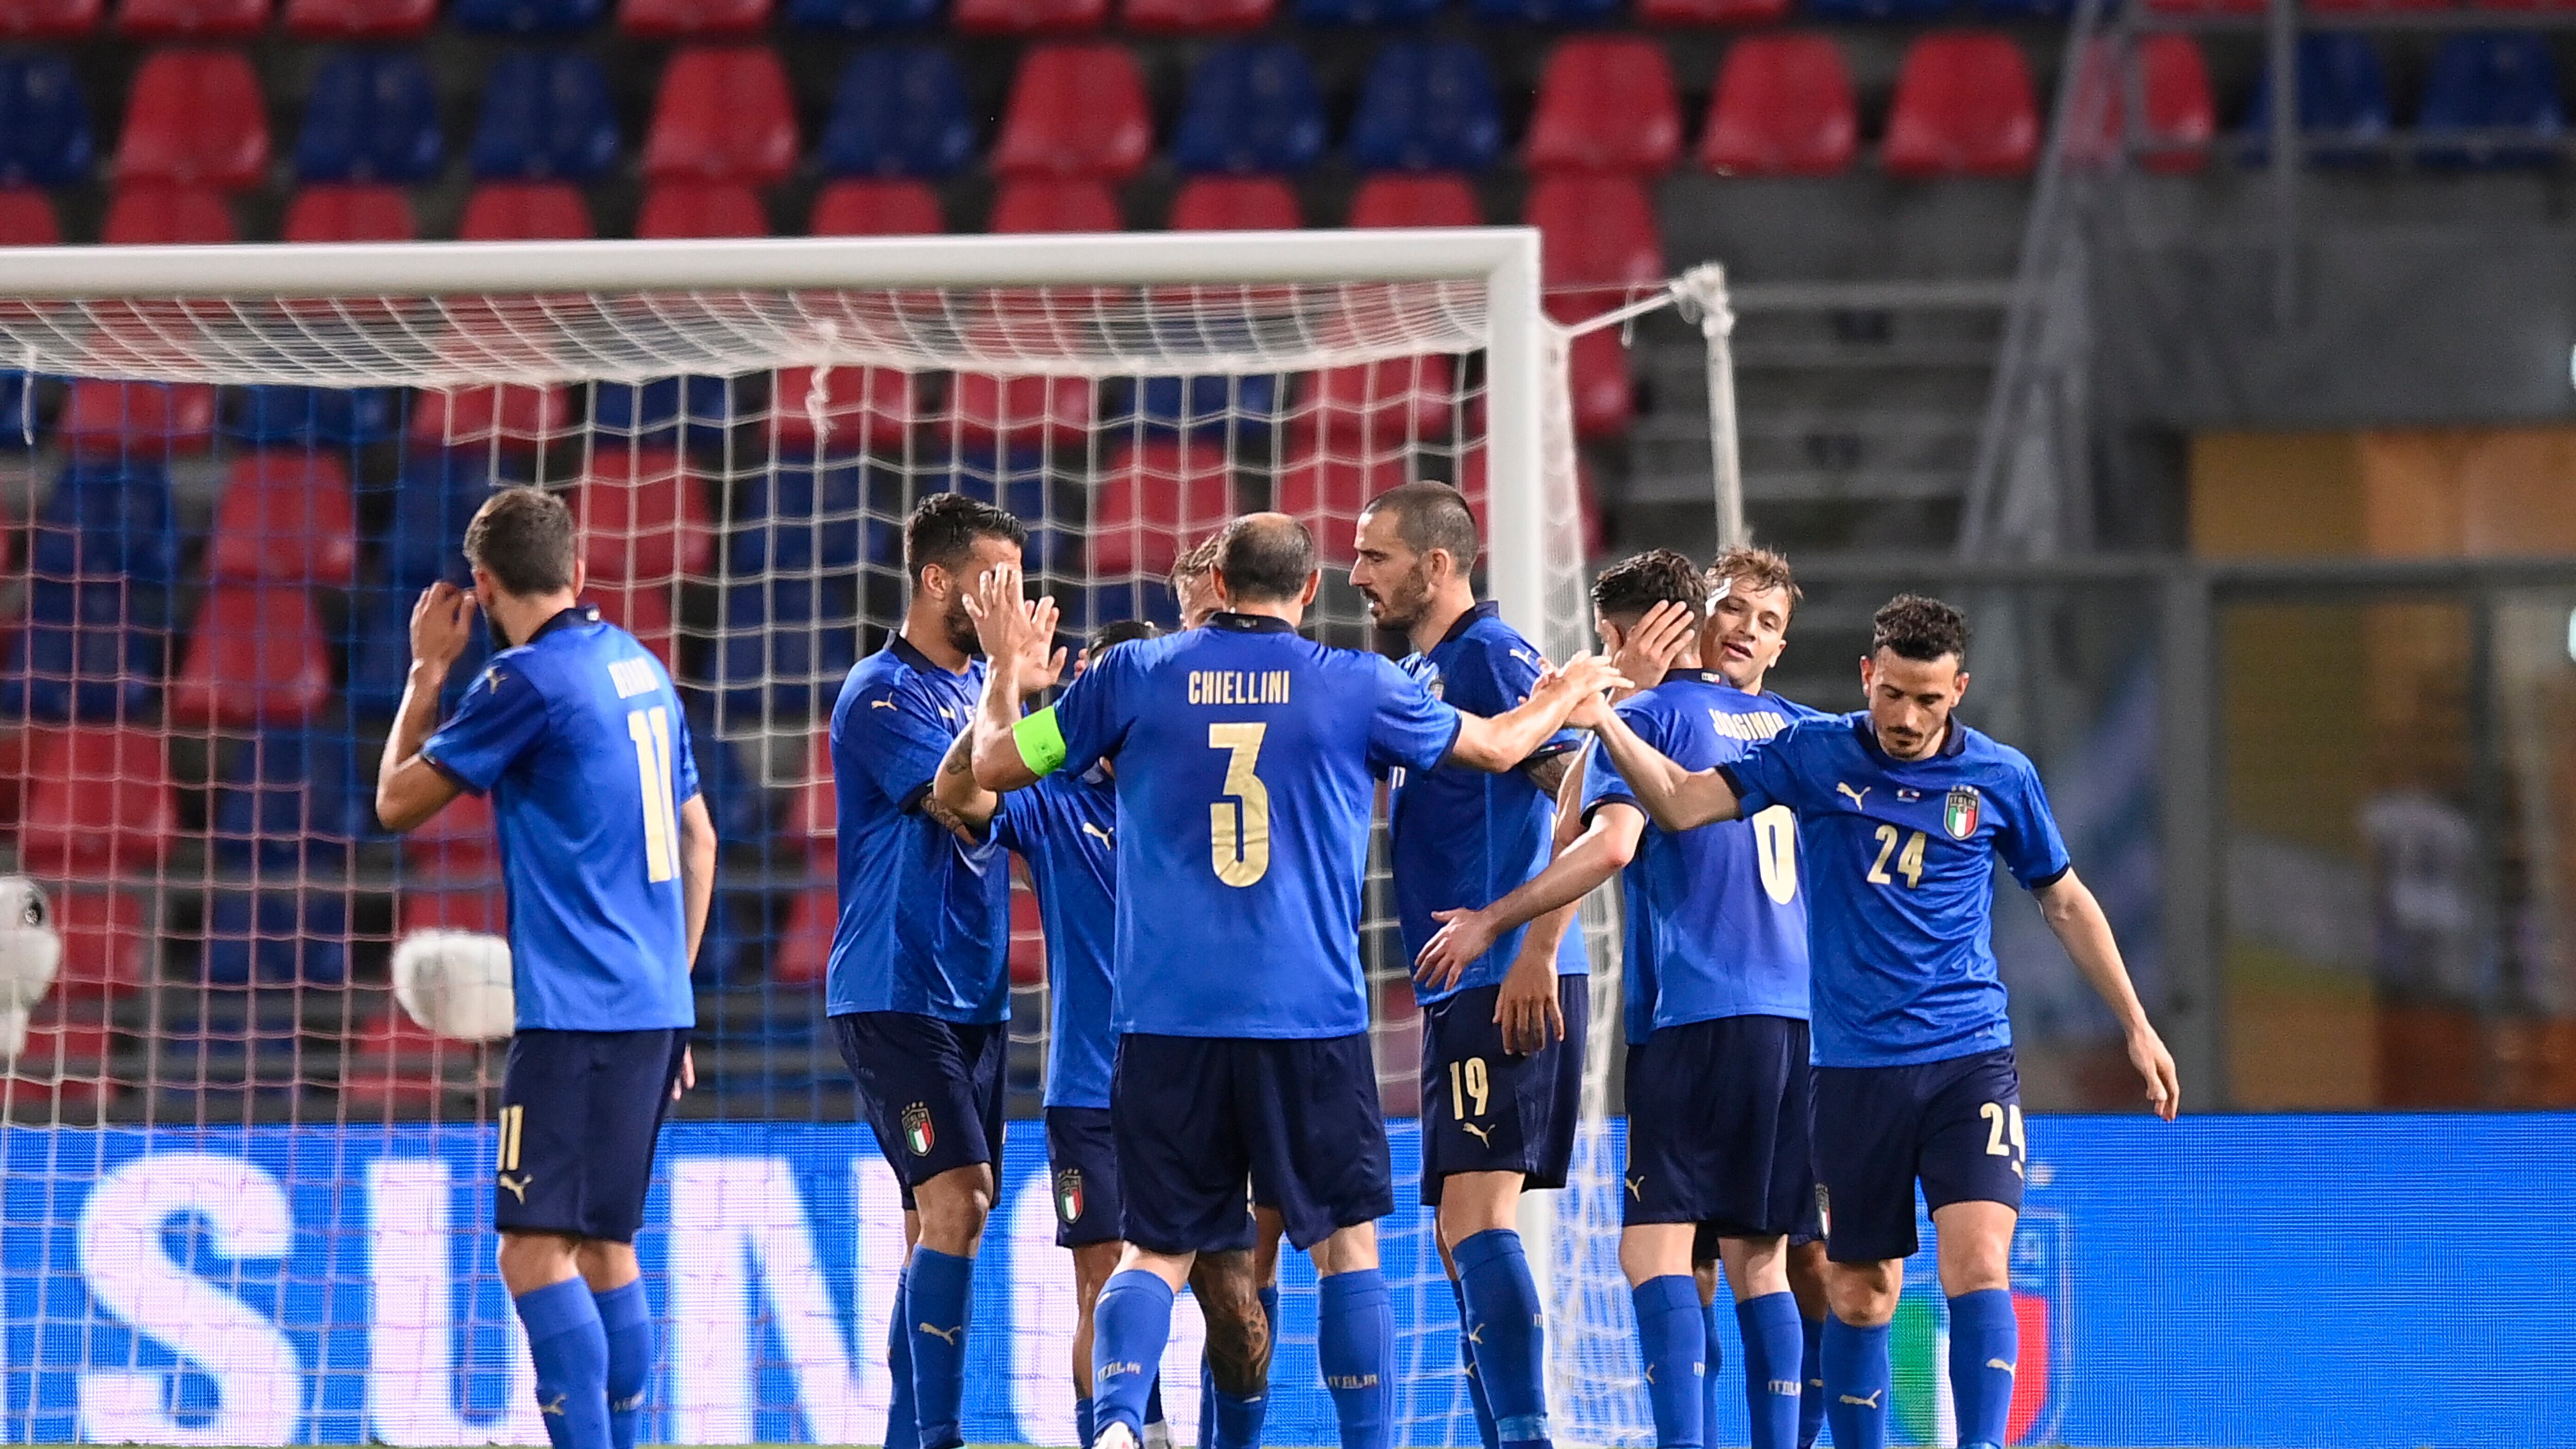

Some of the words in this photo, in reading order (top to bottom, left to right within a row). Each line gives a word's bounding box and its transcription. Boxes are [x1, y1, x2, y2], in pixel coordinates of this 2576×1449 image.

[1188, 670, 1290, 705] CHIELLINI
[627, 706, 680, 884] 11
[1209, 723, 1269, 888] 3
[1867, 824, 1926, 889] 24
[1449, 1057, 1489, 1120] 19
[497, 1105, 524, 1171] 11
[1097, 1361, 1142, 1383] ITALIA
[1328, 1374, 1377, 1389] ITALIA
